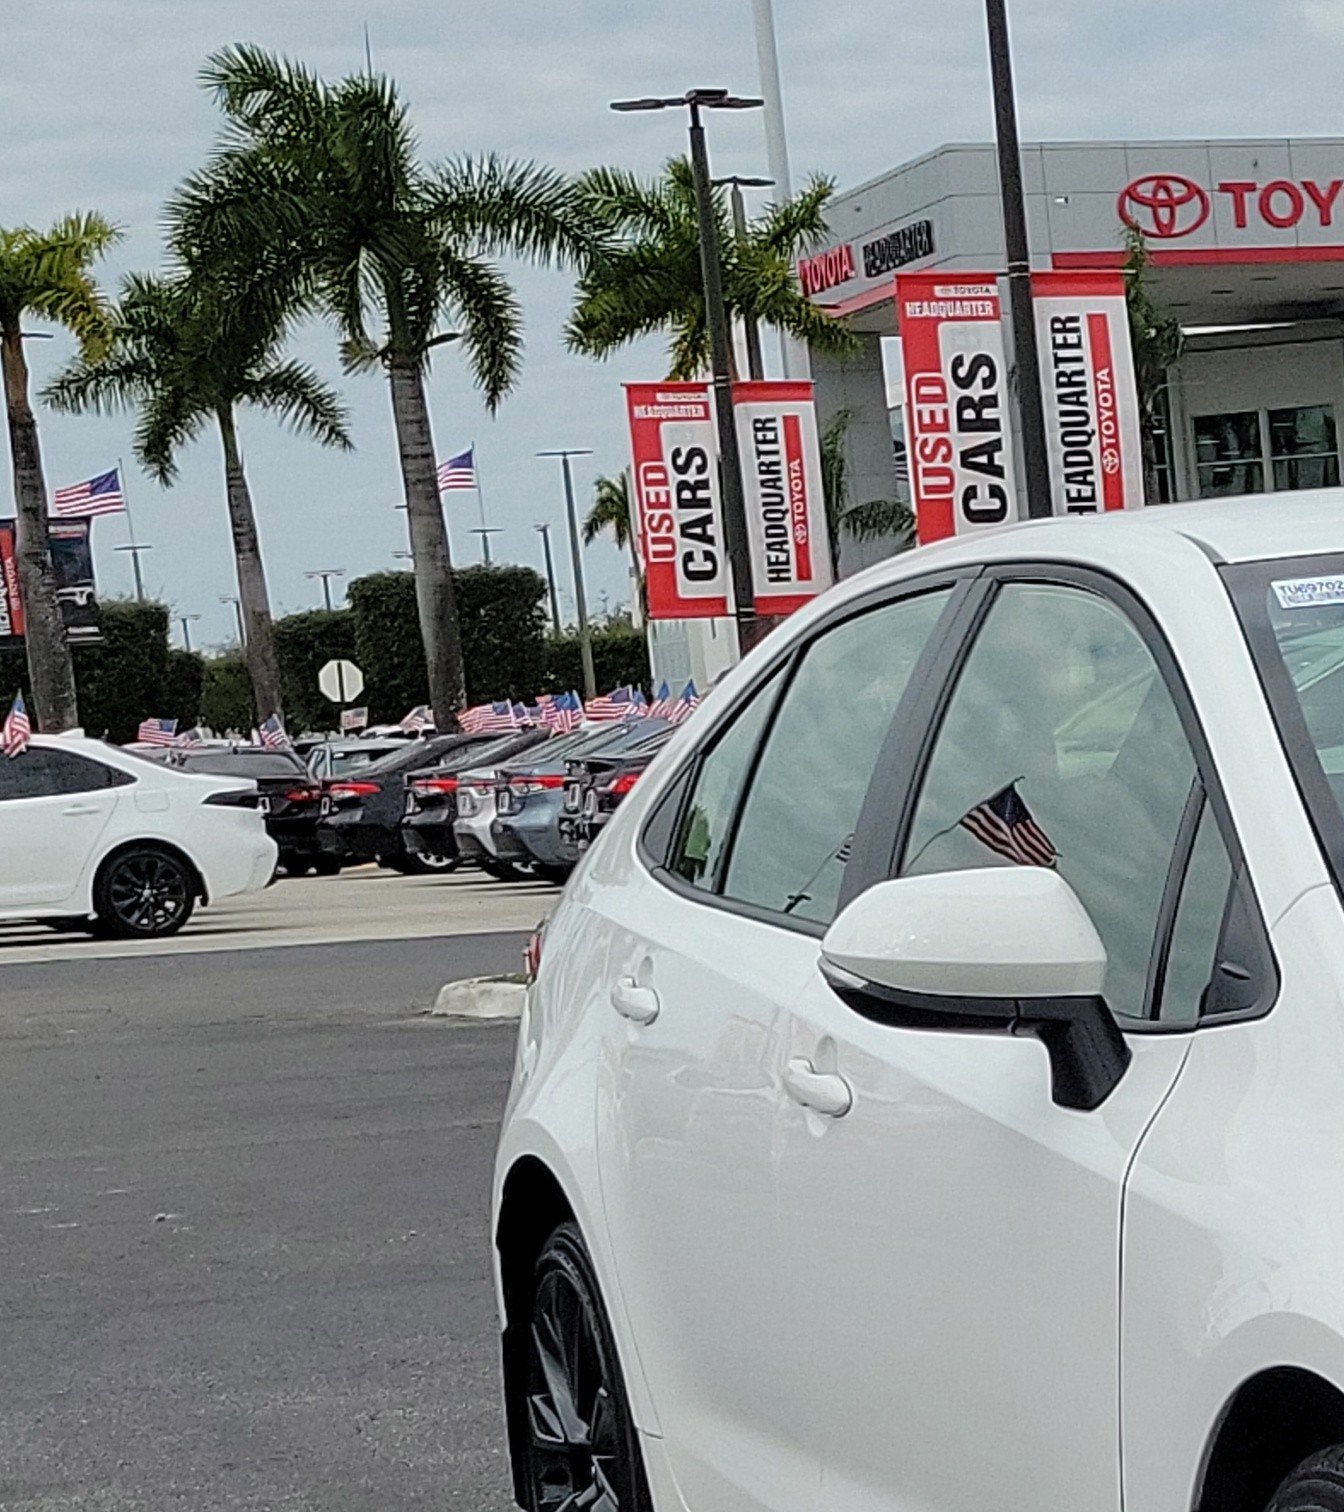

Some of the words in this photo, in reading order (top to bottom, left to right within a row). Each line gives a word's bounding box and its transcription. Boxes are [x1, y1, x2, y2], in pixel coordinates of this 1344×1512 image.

[798, 246, 853, 298] TOYOTA
[913, 374, 955, 498] USED
[951, 353, 1008, 524] CARS
[1096, 368, 1116, 446] TOYOTA
[642, 463, 677, 562] USED
[671, 446, 718, 582] CARS
[752, 417, 792, 583] HEADQUARTER
[789, 457, 808, 524] TOYOTA
